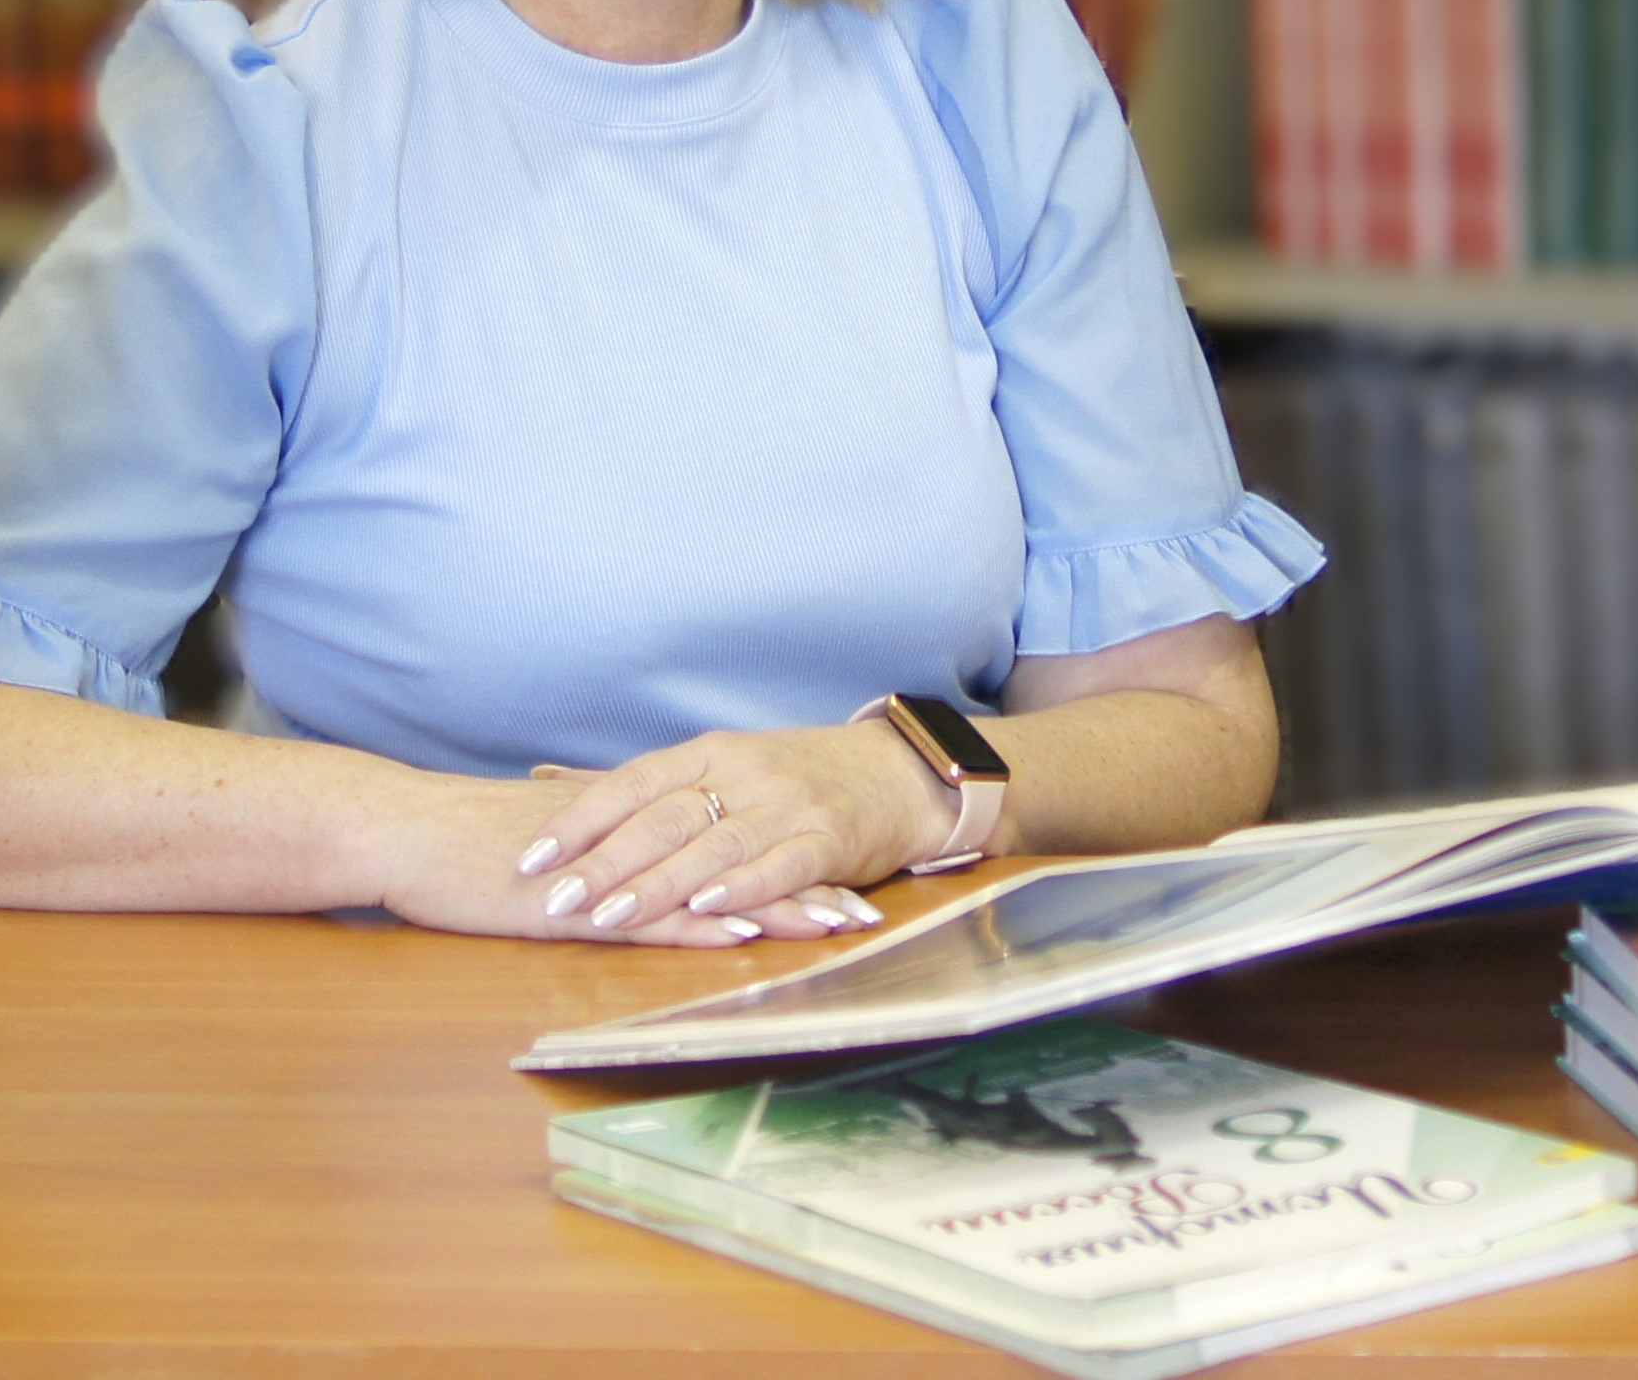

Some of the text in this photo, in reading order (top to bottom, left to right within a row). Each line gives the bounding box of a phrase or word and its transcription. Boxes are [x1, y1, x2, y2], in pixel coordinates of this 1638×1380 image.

[1212, 1107, 1345, 1164] 8
[923, 1168, 1245, 1234] России
[1019, 1174, 1478, 1266] История
